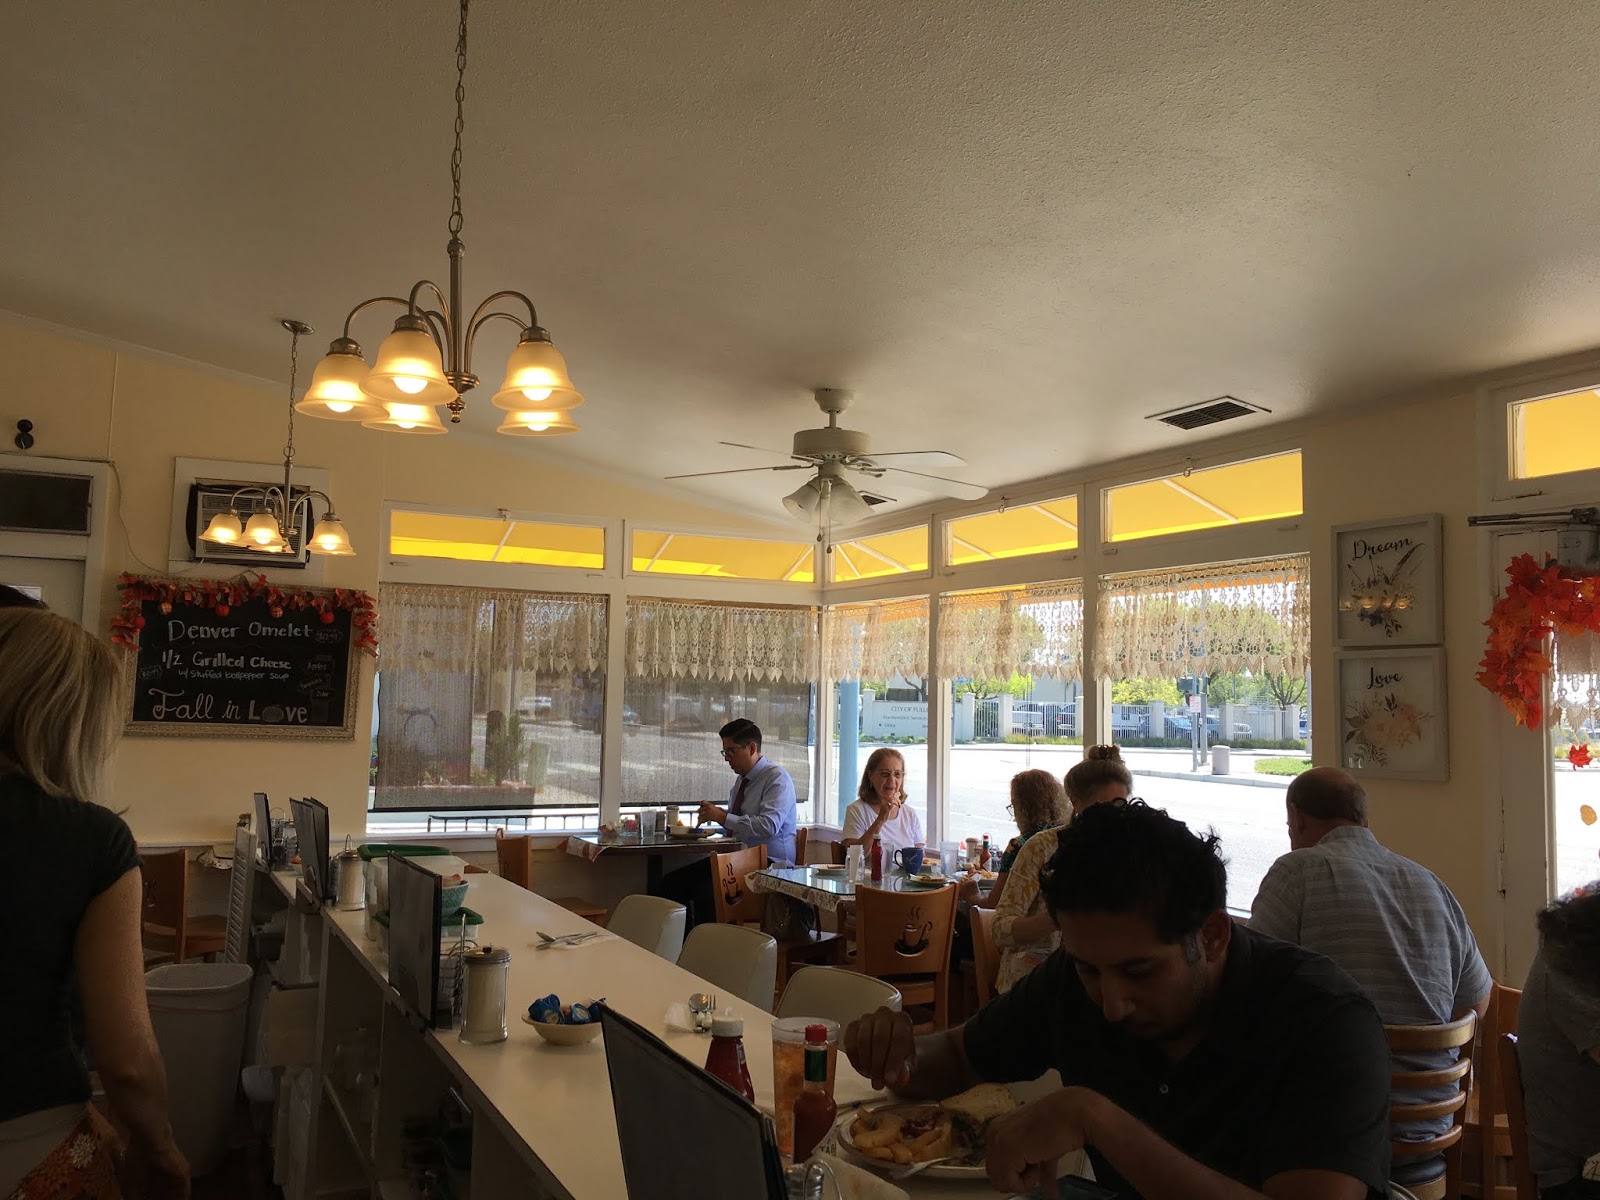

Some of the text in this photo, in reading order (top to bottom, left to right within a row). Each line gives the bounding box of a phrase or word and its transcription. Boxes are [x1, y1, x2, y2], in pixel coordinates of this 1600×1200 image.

[1352, 537, 1414, 561] Dream
[168, 619, 313, 642] Denver Omelet
[161, 649, 292, 670] 1/2 Grilled Cheese
[178, 669, 189, 679] w/
[225, 670, 265, 681] bellpepper
[269, 672, 290, 682] soup
[1367, 666, 1404, 690] Love
[148, 688, 214, 720] Fall
[221, 700, 242, 721] in
